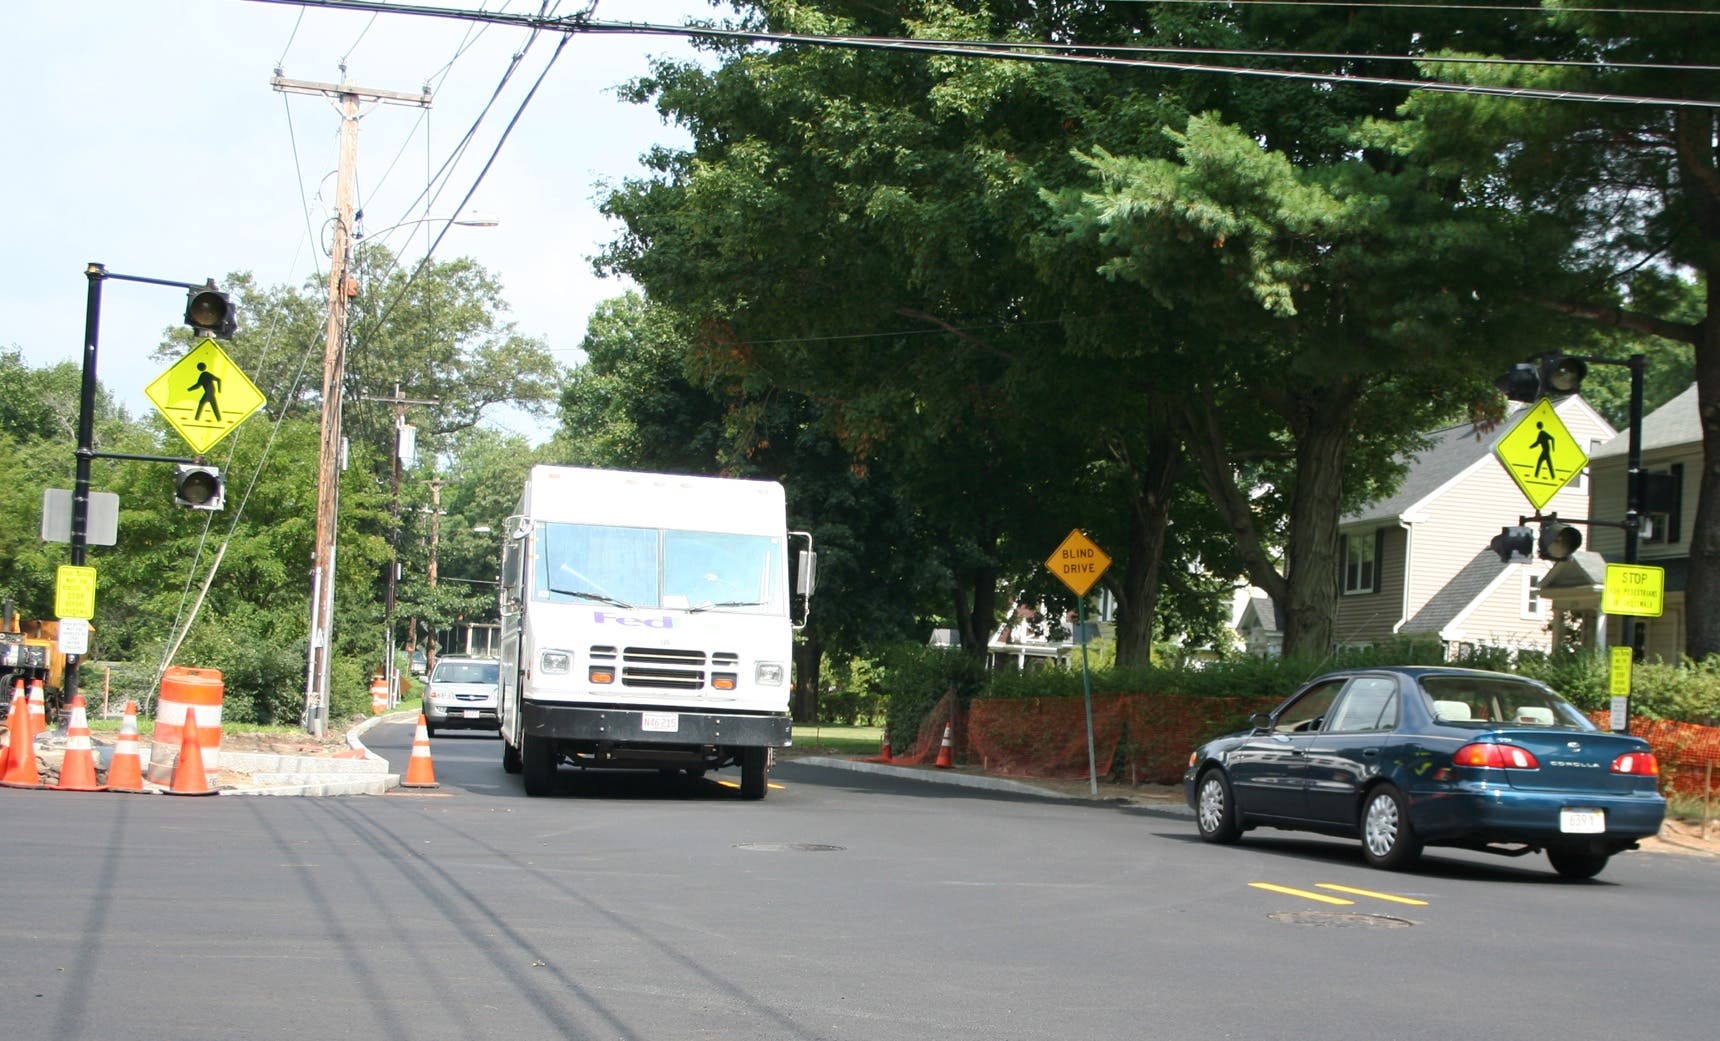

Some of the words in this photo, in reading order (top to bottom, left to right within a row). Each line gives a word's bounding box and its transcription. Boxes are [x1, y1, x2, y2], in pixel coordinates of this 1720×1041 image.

[1062, 549, 1094, 559] BLIND
[1063, 563, 1095, 573] DRIVE
[1622, 572, 1648, 584] STOP
[1550, 760, 1600, 768] COROLLA
